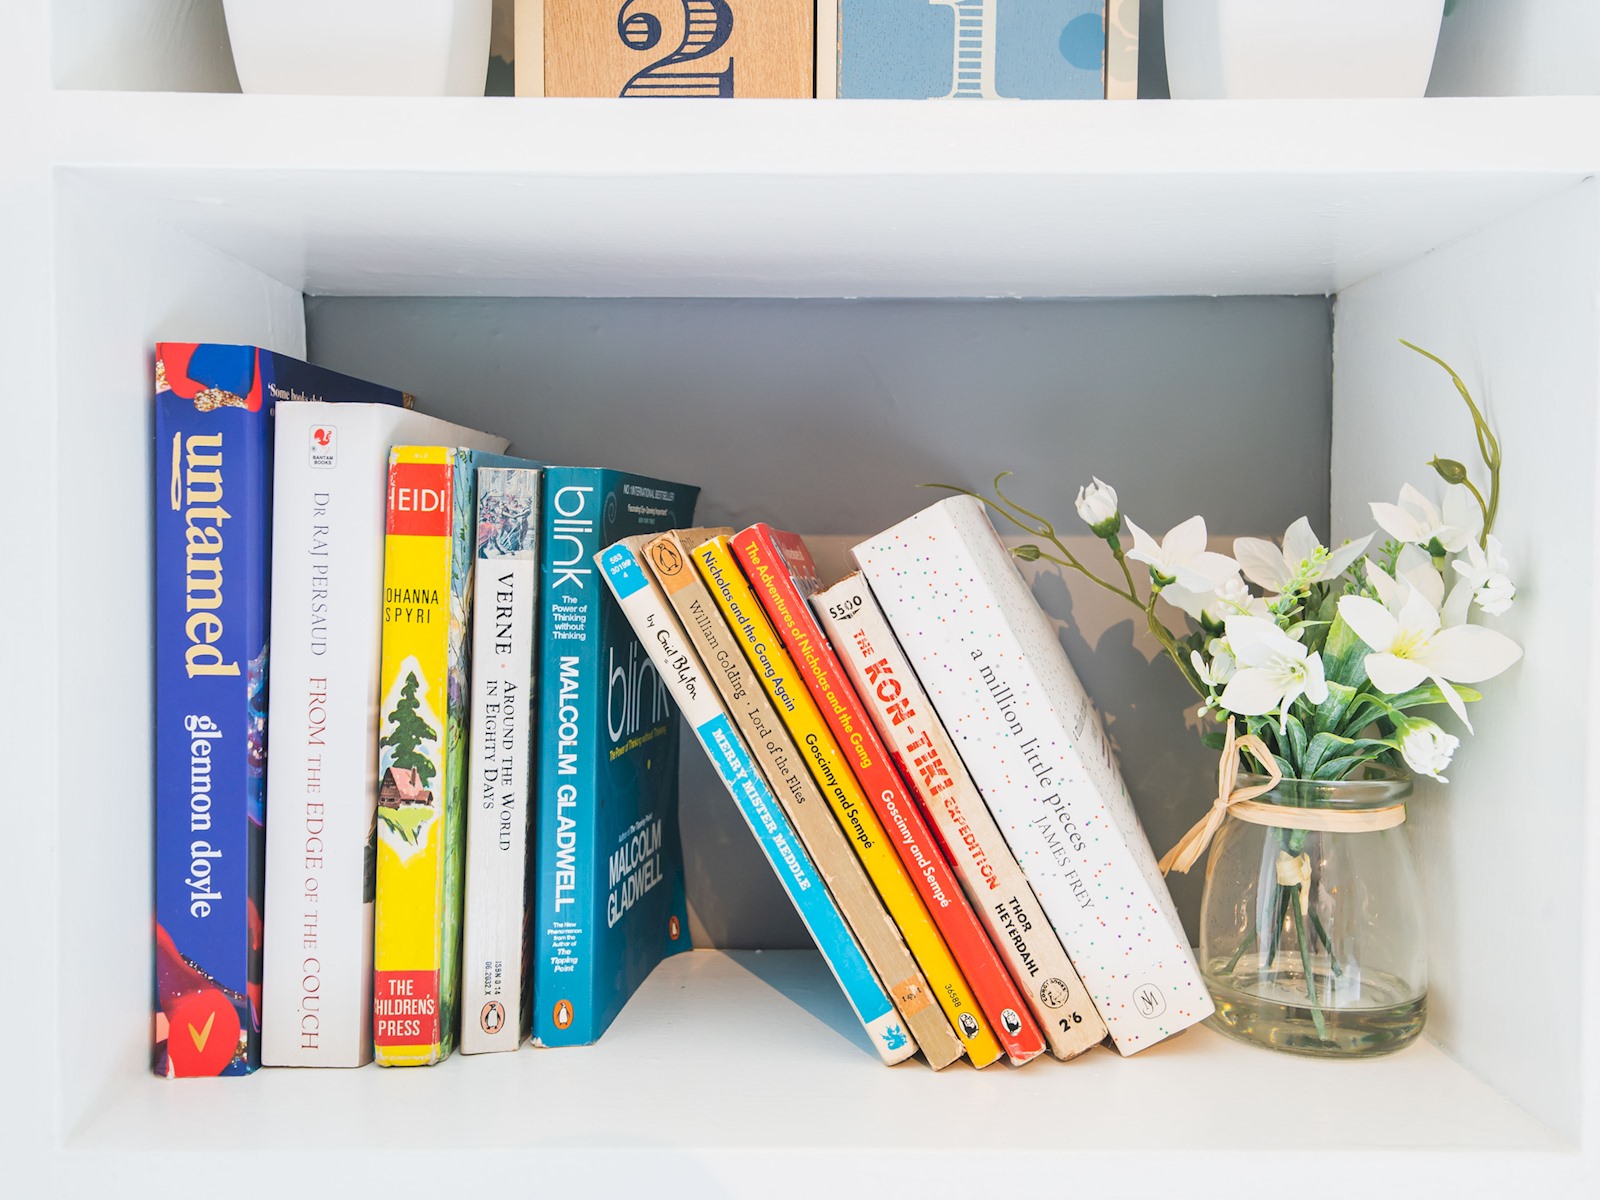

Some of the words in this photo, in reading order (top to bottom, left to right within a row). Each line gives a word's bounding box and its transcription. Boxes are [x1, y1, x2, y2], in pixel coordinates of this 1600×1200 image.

[185, 432, 242, 679] untamed
[308, 525, 329, 557] RAJ
[552, 485, 594, 590] blink
[745, 541, 761, 565] The
[311, 565, 329, 656] PERSAUD
[385, 607, 431, 624] SPYRI
[386, 587, 439, 605] OHANNA
[495, 572, 514, 655] VERNE
[551, 604, 578, 613] Power
[579, 604, 588, 613] of
[561, 595, 578, 604] The
[756, 565, 796, 629] Adventures
[552, 613, 587, 623] Thinking
[552, 631, 587, 641] Thinking
[554, 622, 585, 631] without
[689, 599, 719, 650] William
[791, 626, 807, 642] of
[646, 613, 656, 628] by
[672, 654, 698, 701] Blyton
[716, 649, 747, 700] Golding
[798, 637, 829, 691] Nicholas
[486, 680, 498, 697] IN
[702, 550, 734, 602] Nicholas
[729, 602, 751, 625] and
[742, 622, 757, 643] the
[754, 642, 776, 678] Gang
[772, 677, 795, 712] Again
[805, 733, 839, 788] Goscinny
[834, 786, 855, 811] and
[846, 805, 875, 849] Sempé
[825, 692, 842, 715] and
[307, 677, 327, 746] FROM
[501, 680, 518, 751] AROUND
[557, 655, 579, 775] MALCOLM
[748, 708, 772, 739] Lord
[838, 713, 854, 733] the
[484, 703, 500, 762] EIGHTY
[766, 741, 783, 755] of
[850, 732, 873, 769] Gang
[970, 648, 983, 661] a
[979, 664, 1025, 737] million
[1020, 737, 1053, 788] little
[1041, 792, 1087, 852] pieces
[184, 714, 223, 833] glennon
[307, 754, 322, 794] THE
[500, 756, 513, 787] THE
[774, 756, 790, 776] the
[853, 628, 875, 658] THE
[943, 796, 1001, 891] EXPEDITION
[482, 768, 499, 810] DAYS
[712, 727, 748, 780] MERRY
[742, 780, 778, 834] MISTER
[772, 832, 812, 892] MEDDLE
[786, 774, 806, 804] Flies
[305, 801, 325, 869] EDGE
[499, 791, 514, 852] WORLD
[881, 789, 915, 844] Goscinny
[555, 784, 577, 913] GLADWELL
[609, 819, 662, 890] MALCOLM
[910, 843, 932, 869] and
[1032, 815, 1072, 867] JAMES
[1064, 869, 1096, 911] FREY
[184, 841, 223, 918] doyle
[304, 877, 319, 904] OF
[607, 853, 663, 929] GLADWELL
[923, 863, 952, 909] Sempé
[303, 910, 318, 949] THE
[1008, 896, 1033, 933] THOR
[550, 956, 579, 965] Tipping
[994, 903, 1041, 978] HEYERDAHL
[388, 979, 414, 996] THE
[554, 964, 575, 973] Point
[300, 957, 321, 1050] COUCH
[375, 994, 435, 1016] HILDREN'S
[944, 983, 962, 1008] 36588
[378, 1019, 421, 1037] PRESS
